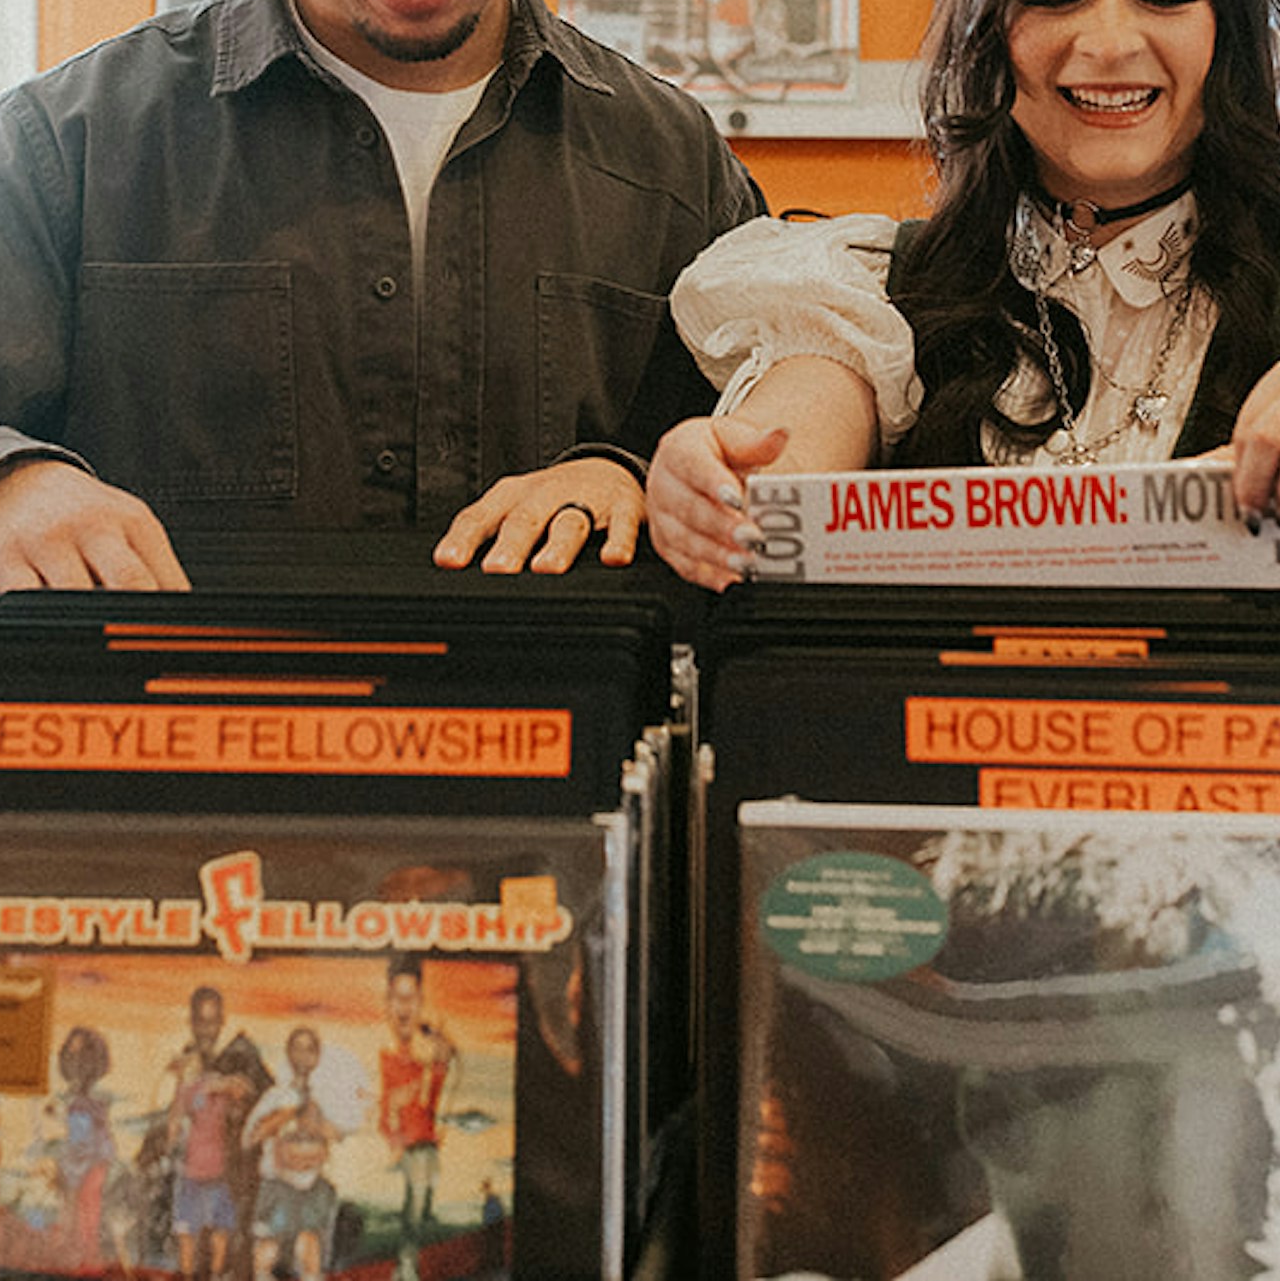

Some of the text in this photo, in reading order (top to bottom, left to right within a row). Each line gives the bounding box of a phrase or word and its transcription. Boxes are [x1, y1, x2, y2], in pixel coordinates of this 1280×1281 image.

[825, 478, 955, 533] JAMES
[967, 473, 1128, 528] BROWN:
[219, 715, 562, 764] FELLOWSHIP
[925, 708, 1115, 757] HOUSE
[1132, 712, 1206, 758] OF
[994, 777, 1272, 812] EVERLAST
